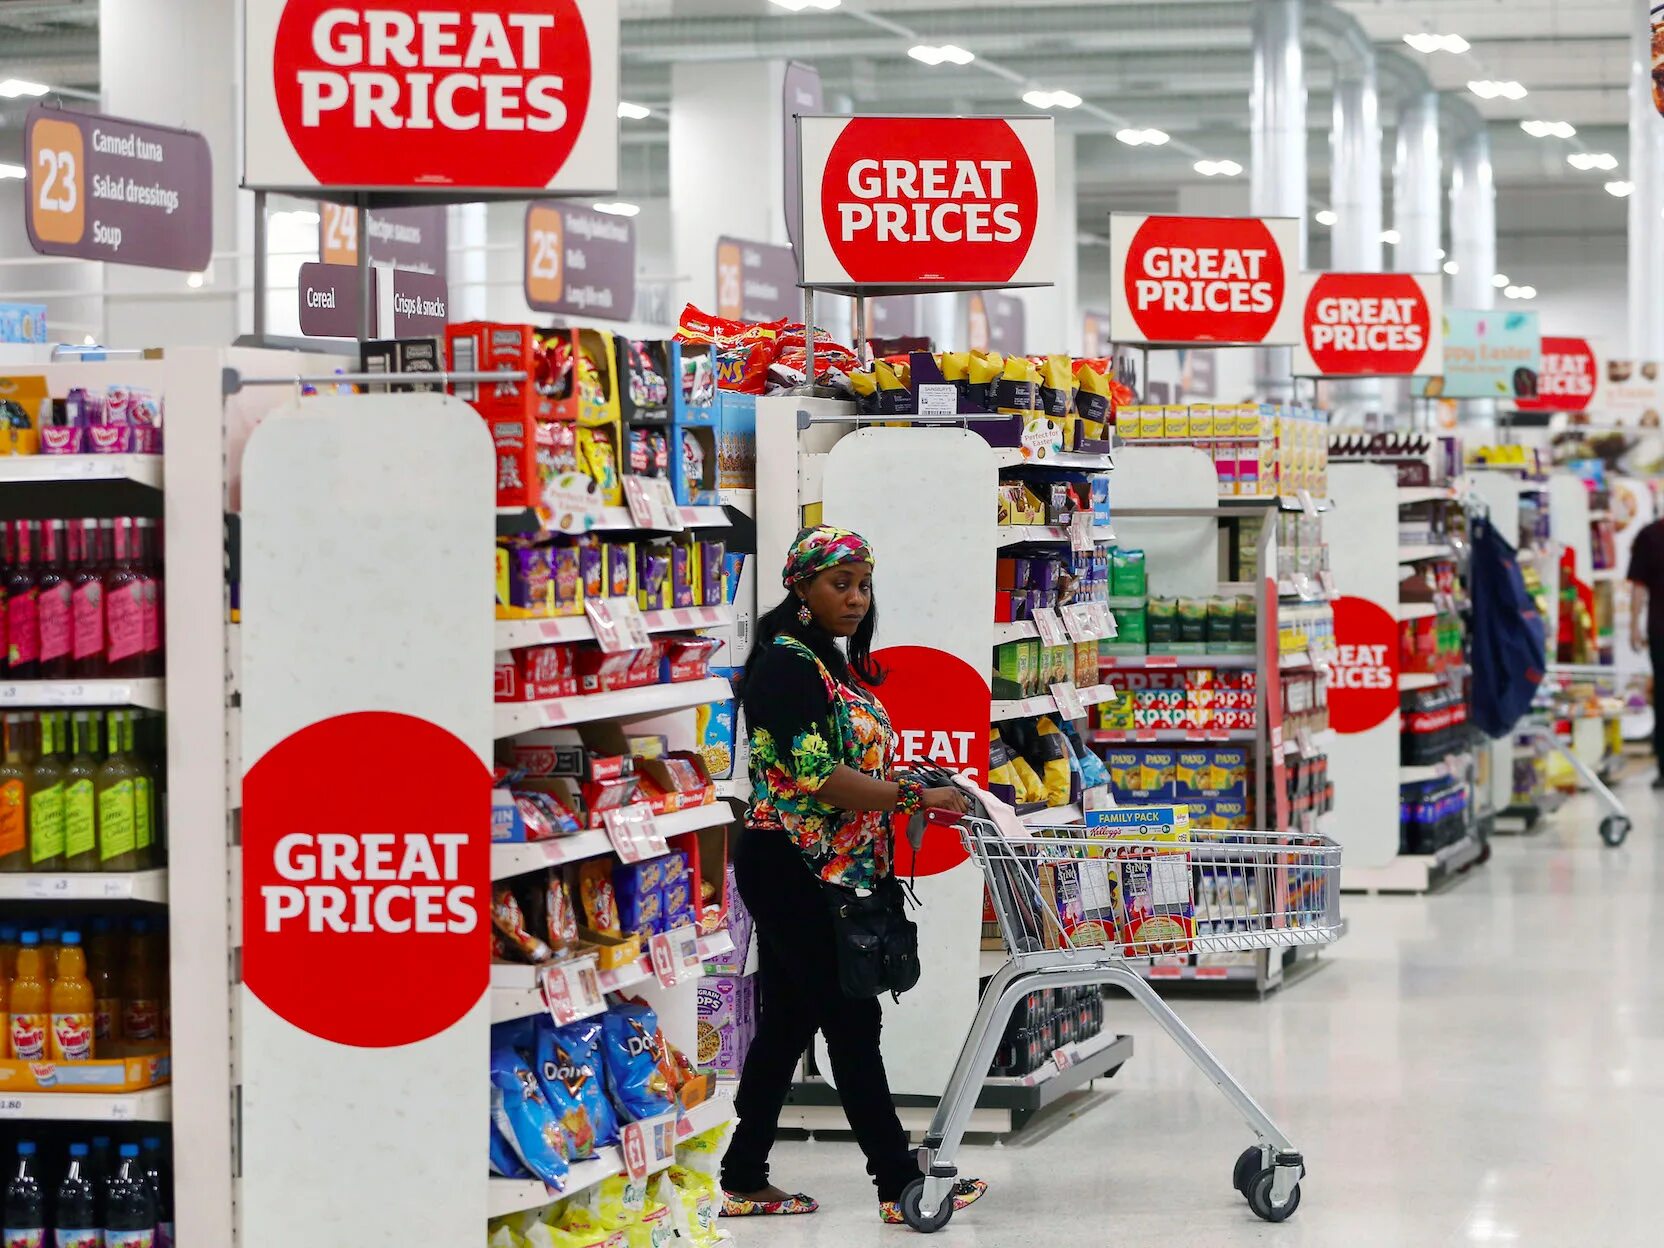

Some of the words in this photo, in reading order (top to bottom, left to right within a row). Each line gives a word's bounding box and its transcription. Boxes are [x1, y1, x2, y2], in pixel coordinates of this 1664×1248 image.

[311, 7, 555, 70] GREAT
[297, 71, 568, 132] PRICES
[92, 129, 135, 158] Canned
[137, 137, 163, 162] tuna
[39, 148, 77, 213] 23
[847, 158, 1012, 200] GREAT
[93, 174, 125, 201] Salad
[126, 178, 179, 214] dressings
[93, 220, 122, 251] Soup
[325, 202, 357, 251] 24
[837, 202, 1022, 243] PRICES
[531, 231, 557, 280] 25
[1142, 246, 1266, 281] GREAT
[307, 287, 335, 309] Cereal
[394, 293, 416, 319] Crisps
[416, 296, 423, 314] &
[423, 297, 445, 318] snacks
[1137, 280, 1273, 314] PRICES
[1317, 297, 1417, 325] GREAT
[1312, 323, 1423, 352] PRICES
[1541, 353, 1590, 373] EAT
[1539, 374, 1592, 396] ICES
[1024, 431, 1048, 442] Perfect
[1032, 438, 1053, 447] Easter
[1329, 644, 1388, 666] REAT
[1326, 666, 1393, 689] RICES
[892, 729, 976, 764] EAT
[1110, 754, 1136, 765] PAXO
[1145, 754, 1171, 765] PAXO
[1181, 754, 1206, 765] PAXO
[1215, 754, 1241, 765] PAXO
[1098, 813, 1133, 823] FAMILY
[1134, 812, 1159, 822] PACK
[1089, 826, 1122, 838] Kellogg's
[273, 832, 469, 881] GREAT
[260, 885, 478, 934] PRICES
[697, 988, 722, 1000] GRAIN
[697, 996, 722, 1010] OPS
